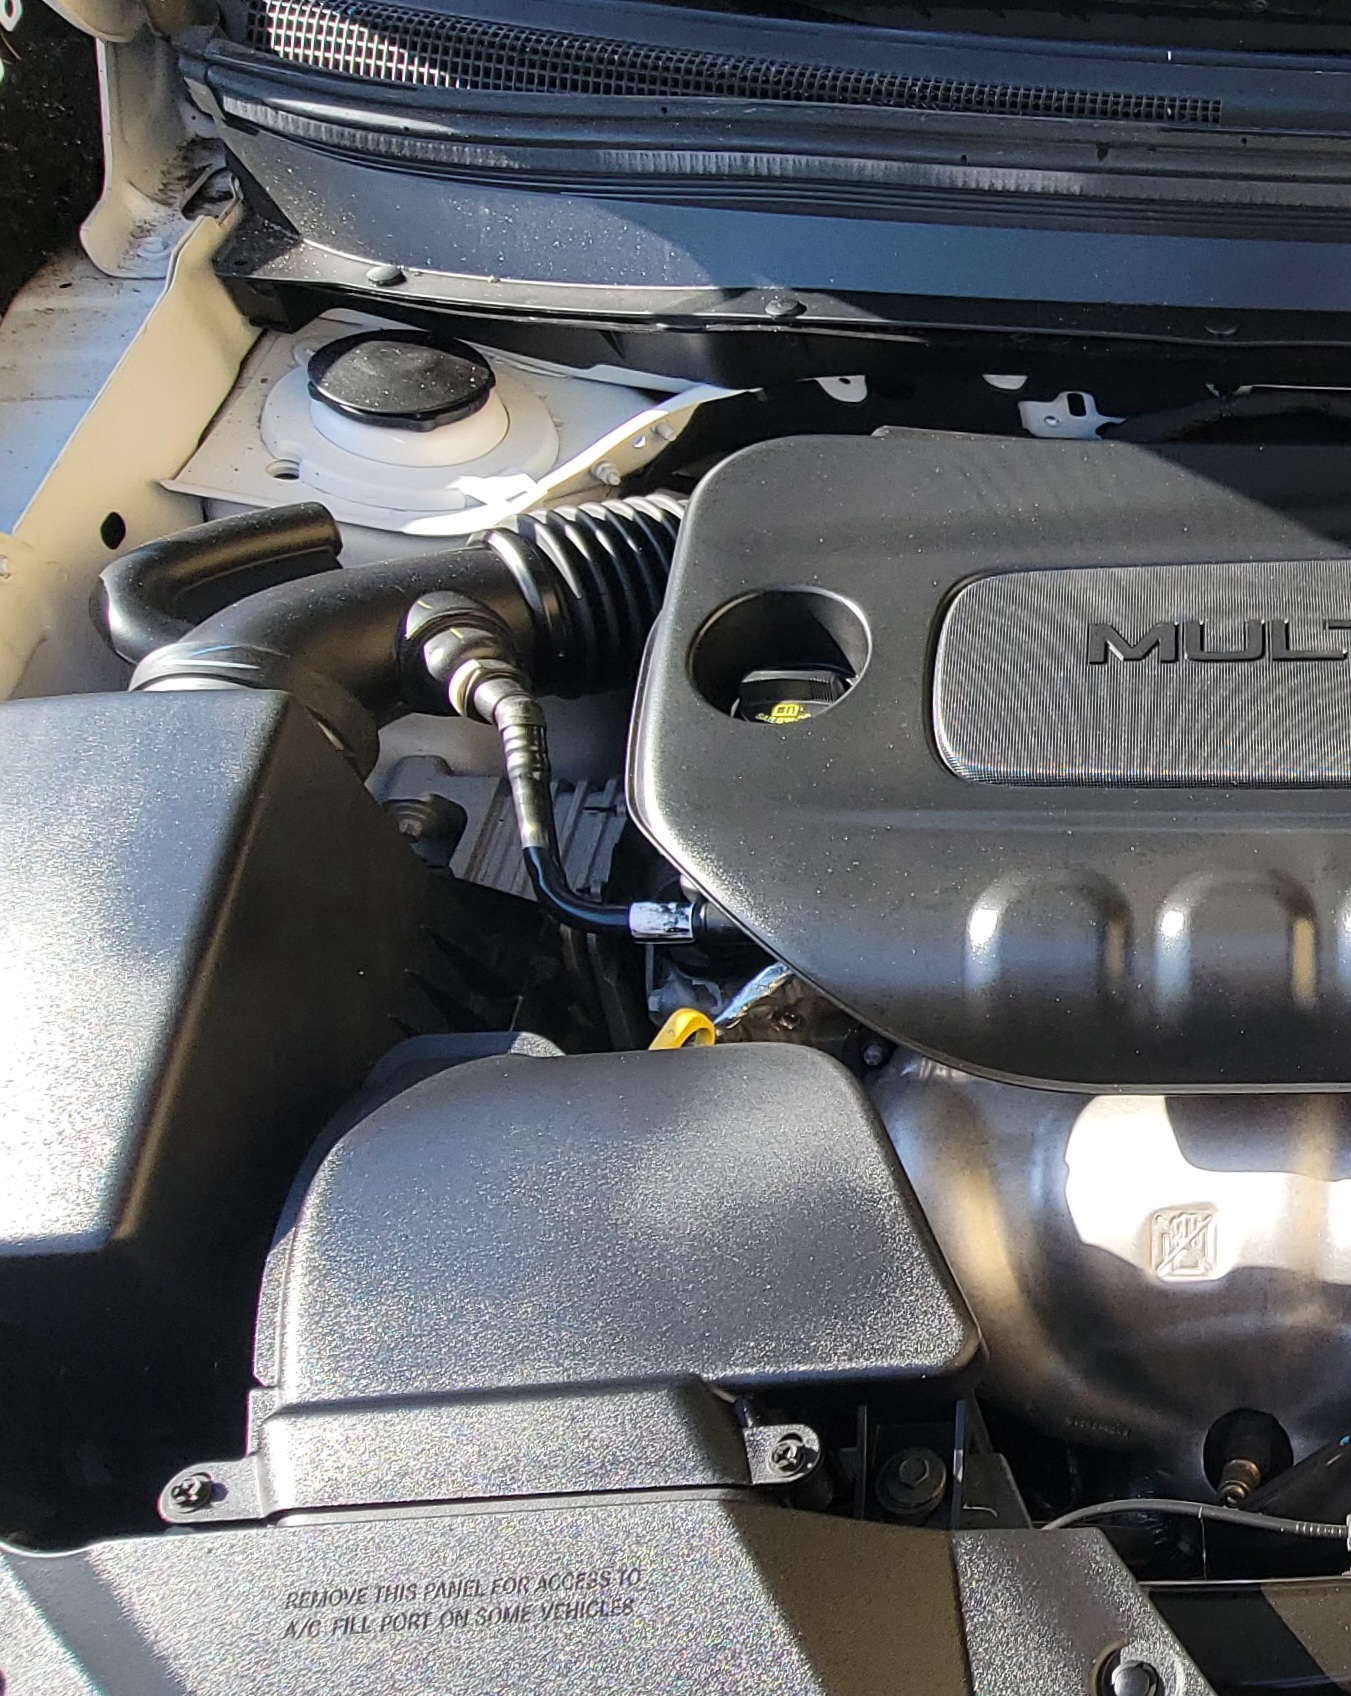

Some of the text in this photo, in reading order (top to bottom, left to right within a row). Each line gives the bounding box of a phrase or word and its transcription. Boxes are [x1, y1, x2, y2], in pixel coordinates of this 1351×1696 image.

[285, 1567, 642, 1609] REMOVE THIS PANEL FOR ACCESS TO
[281, 1599, 635, 1640] A/C FILL PORT ON SOME VEHICLES
